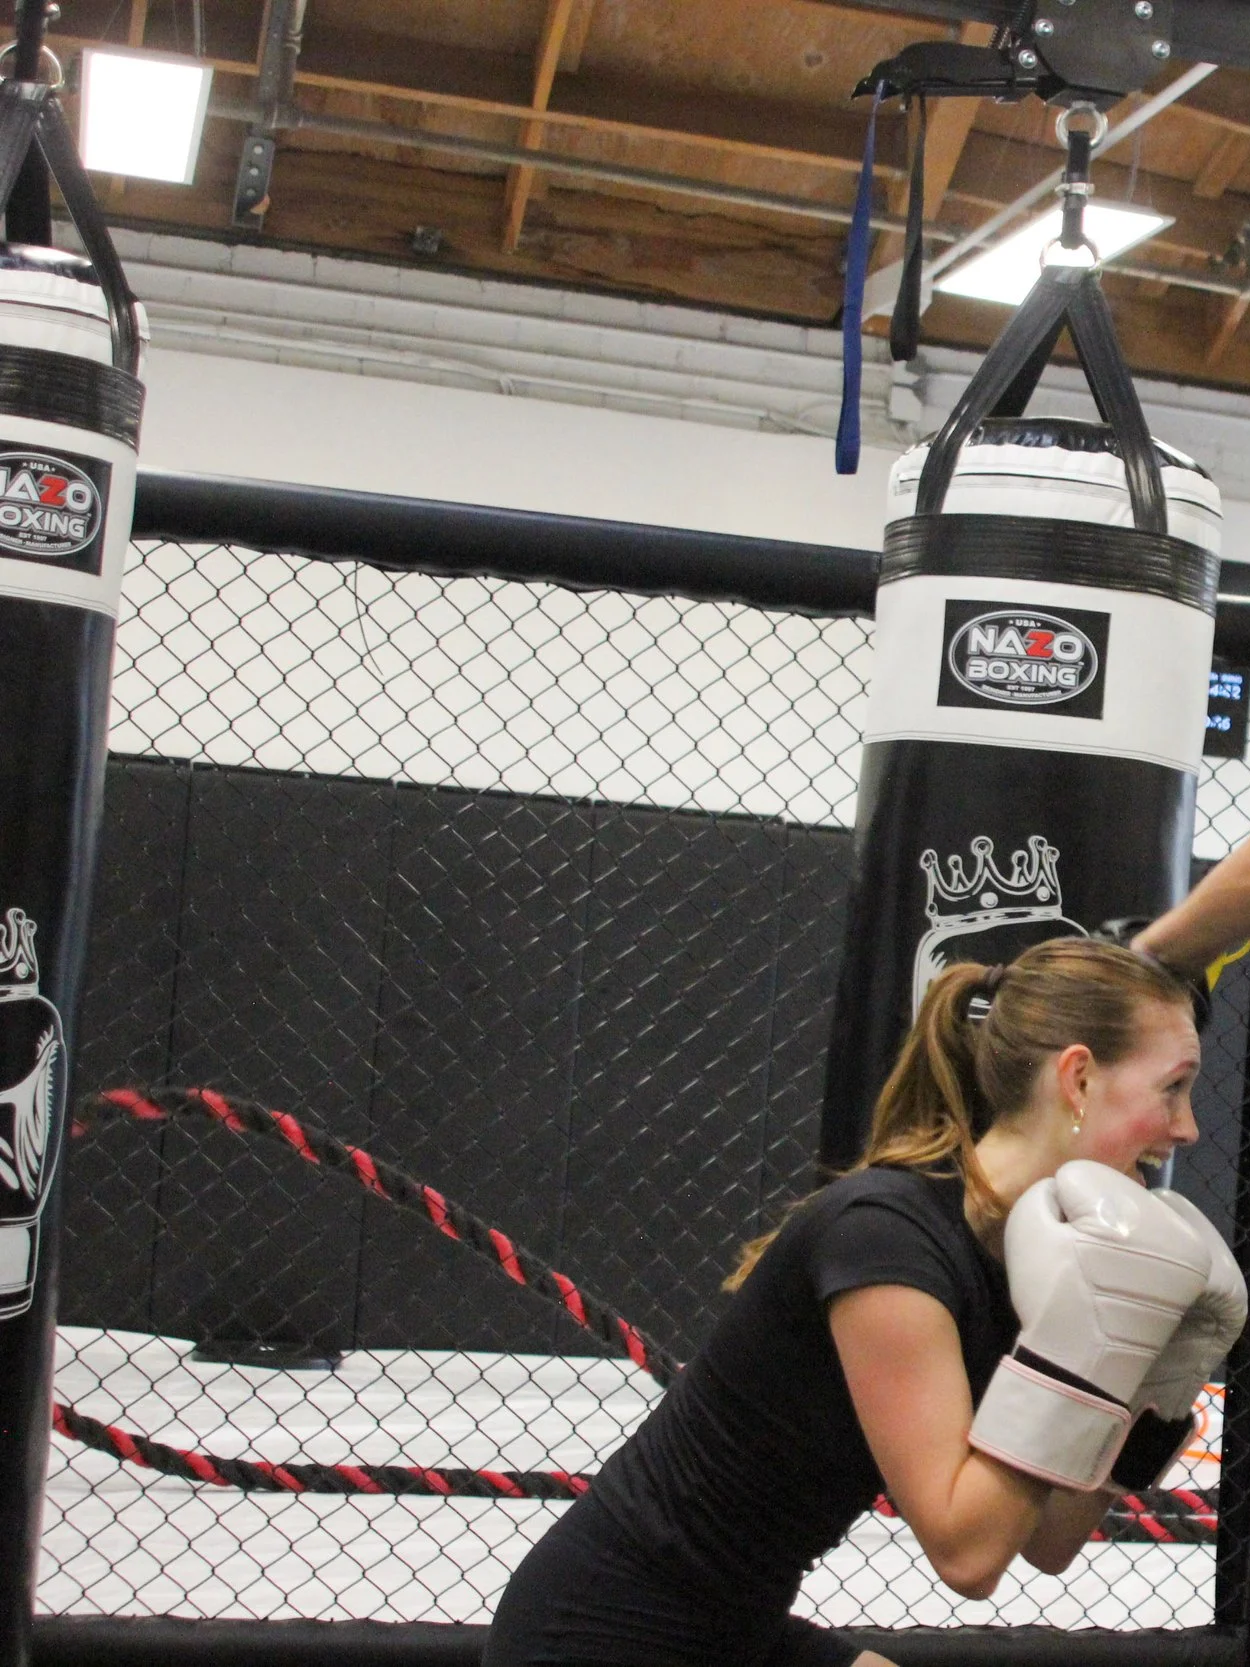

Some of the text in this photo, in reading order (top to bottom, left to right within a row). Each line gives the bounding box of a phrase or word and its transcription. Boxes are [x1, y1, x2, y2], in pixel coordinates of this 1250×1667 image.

[30, 462, 51, 472] USA
[0, 505, 86, 538] OXING
[1015, 619, 1036, 628] USA
[970, 626, 1083, 662] NAZO
[968, 658, 1077, 687] BOXING
